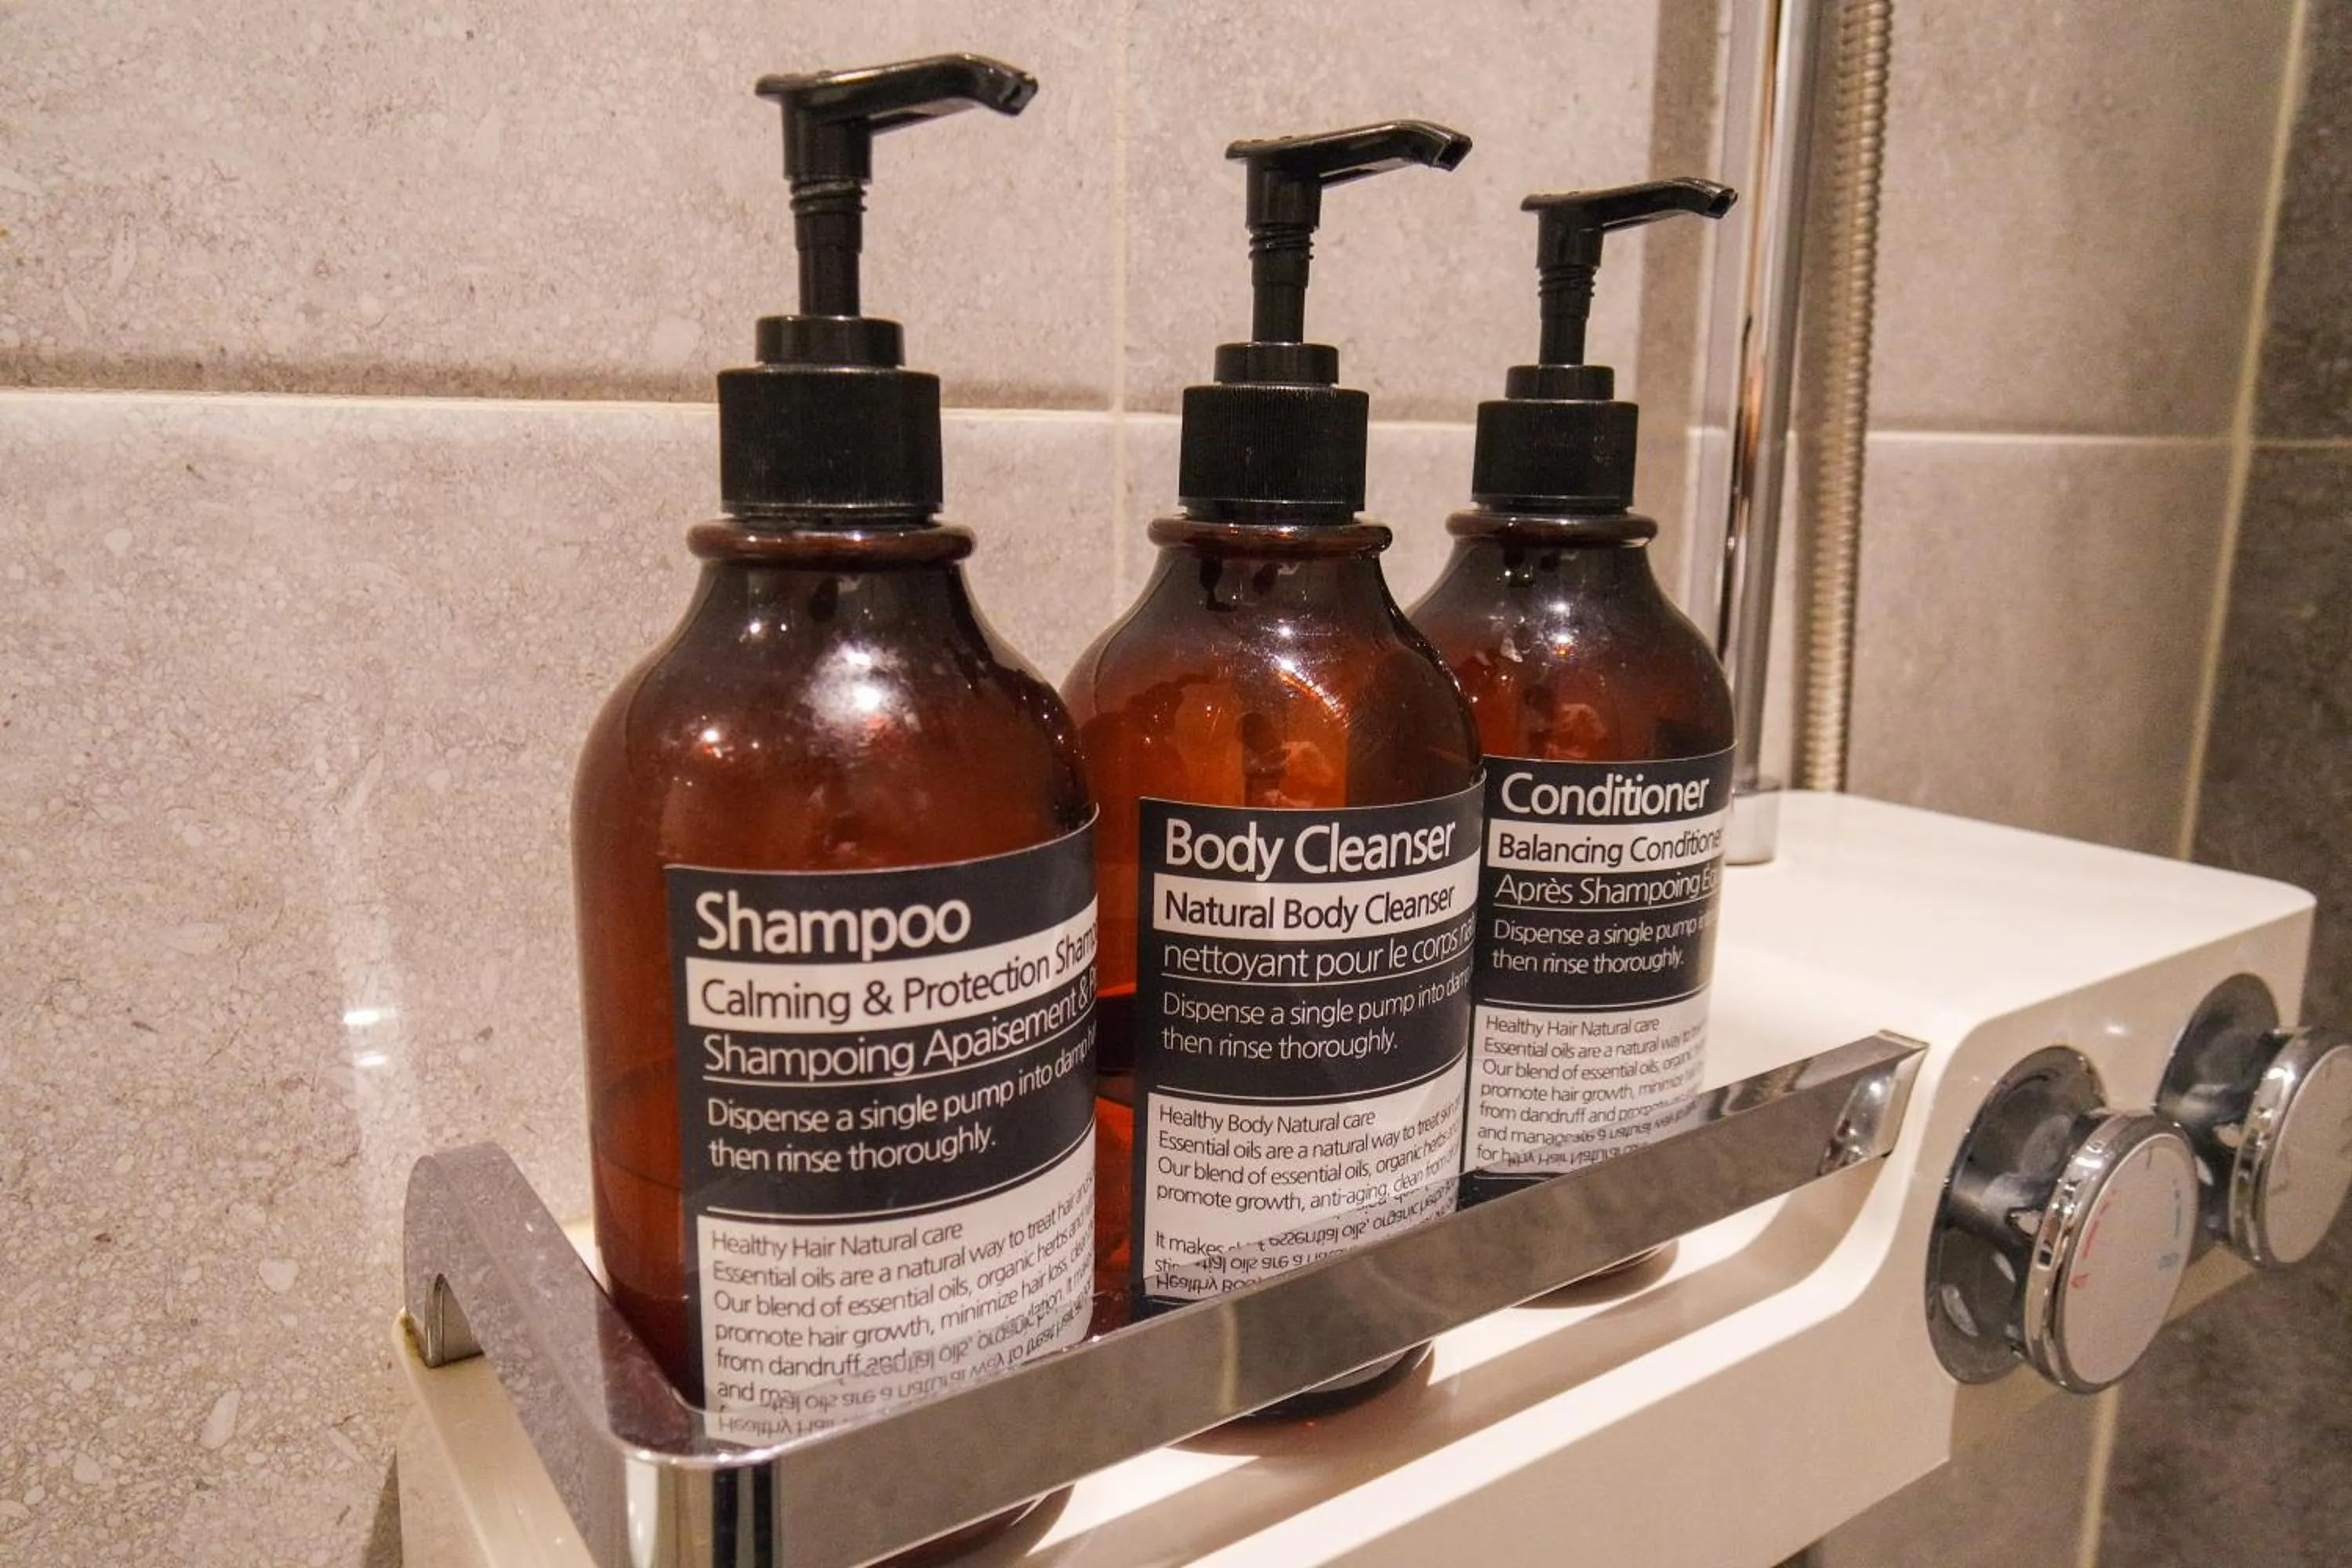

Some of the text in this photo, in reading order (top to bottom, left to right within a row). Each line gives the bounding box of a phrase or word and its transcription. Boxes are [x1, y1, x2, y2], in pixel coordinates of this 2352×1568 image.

[1501, 772, 1711, 817] Conditioner
[1167, 818, 1456, 881] Body Cleanser
[1498, 833, 1624, 866] Balancing
[1494, 873, 1573, 904] Après
[1579, 872, 1700, 906] Shampoing
[695, 890, 971, 960] Shampoo
[1166, 885, 1455, 932] Natural Body Cleanser
[1494, 919, 1584, 945] Dispense
[1588, 927, 1599, 944] a
[1604, 922, 1653, 947] single
[1656, 917, 1697, 941] pump
[1164, 944, 1308, 981] nettoyant
[1316, 946, 1384, 981] pour
[1388, 938, 1407, 970] le
[1413, 928, 1457, 963] corps
[1492, 945, 1684, 975] then rinse thoroughly.
[701, 978, 851, 1025] Calming
[862, 979, 892, 1015] &
[903, 954, 1050, 1012] Protection
[1164, 991, 1264, 1025] Dispense
[1271, 1004, 1283, 1025] a
[1290, 999, 1353, 1031] single
[1358, 992, 1414, 1025] pump
[1418, 982, 1445, 1007] into
[703, 1036, 914, 1082] Shampoing
[923, 989, 1077, 1068] Apaisement
[1079, 975, 1088, 1011] &
[1162, 1027, 1399, 1060] then rinse thoroughly.
[1486, 1015, 1660, 1038] Healthy Hair Natural care
[1484, 1036, 1548, 1058] Essential
[1551, 1042, 1575, 1058] oils
[1577, 1045, 1602, 1058] are
[1603, 1045, 1613, 1058] a
[1616, 1035, 1660, 1056] natural
[1483, 1058, 1514, 1076] Our
[1515, 1062, 1559, 1080] blend
[1562, 1064, 1580, 1080] of
[1581, 1061, 1638, 1080] essential
[707, 1040, 1087, 1135] Dispense a single pump into damp
[1481, 1083, 1548, 1101] promote
[1552, 1087, 1580, 1101] hair
[1159, 1105, 1376, 1138] Healthy Body Natural care
[1480, 1100, 1516, 1119] from
[1520, 1106, 1586, 1123] dandruff
[1588, 1106, 1616, 1123] and
[709, 1122, 996, 1172] then rinse thoroughly.
[1158, 1131, 1230, 1159] Essential
[1233, 1139, 1260, 1160] oils
[1265, 1142, 1294, 1160] are
[1298, 1145, 1308, 1160] a
[1312, 1131, 1369, 1158] natural
[1371, 1130, 1400, 1149] way
[1403, 1125, 1415, 1141] to
[1477, 1126, 1508, 1142] and
[1158, 1157, 1193, 1177] Our
[1194, 1160, 1243, 1185] blend
[1247, 1167, 1268, 1185] of
[1271, 1161, 1341, 1185] essential
[1345, 1157, 1372, 1179] oils,
[1376, 1144, 1423, 1174] organic
[1477, 1145, 1499, 1161] for
[1156, 1184, 1232, 1208] promote
[1236, 1190, 1305, 1214] growth,
[1310, 1181, 1390, 1209] anti-aging,
[712, 1223, 963, 1261] Healthy Hair Natural care
[713, 1260, 796, 1287] Essential
[800, 1266, 836, 1288] oils
[840, 1267, 874, 1285] are
[879, 1266, 891, 1283] a
[897, 1246, 965, 1280] natural
[968, 1237, 1006, 1263] way
[1009, 1229, 1025, 1249] to
[1027, 1207, 1056, 1240] treat
[1156, 1231, 1166, 1250] It
[714, 1290, 752, 1314] Our
[756, 1294, 815, 1318] blend
[819, 1294, 844, 1318] of
[848, 1283, 934, 1317] essential
[938, 1276, 973, 1301] oils,
[977, 1250, 1036, 1290] organic
[1037, 1228, 1068, 1262] herbs
[715, 1323, 803, 1347] promote
[808, 1325, 845, 1347] hair
[853, 1315, 935, 1348] growth,
[941, 1289, 1018, 1330] minimize
[1022, 1271, 1047, 1299] hair
[716, 1347, 764, 1374] from
[768, 1352, 861, 1377] dandruff
[717, 1381, 754, 1401] and
